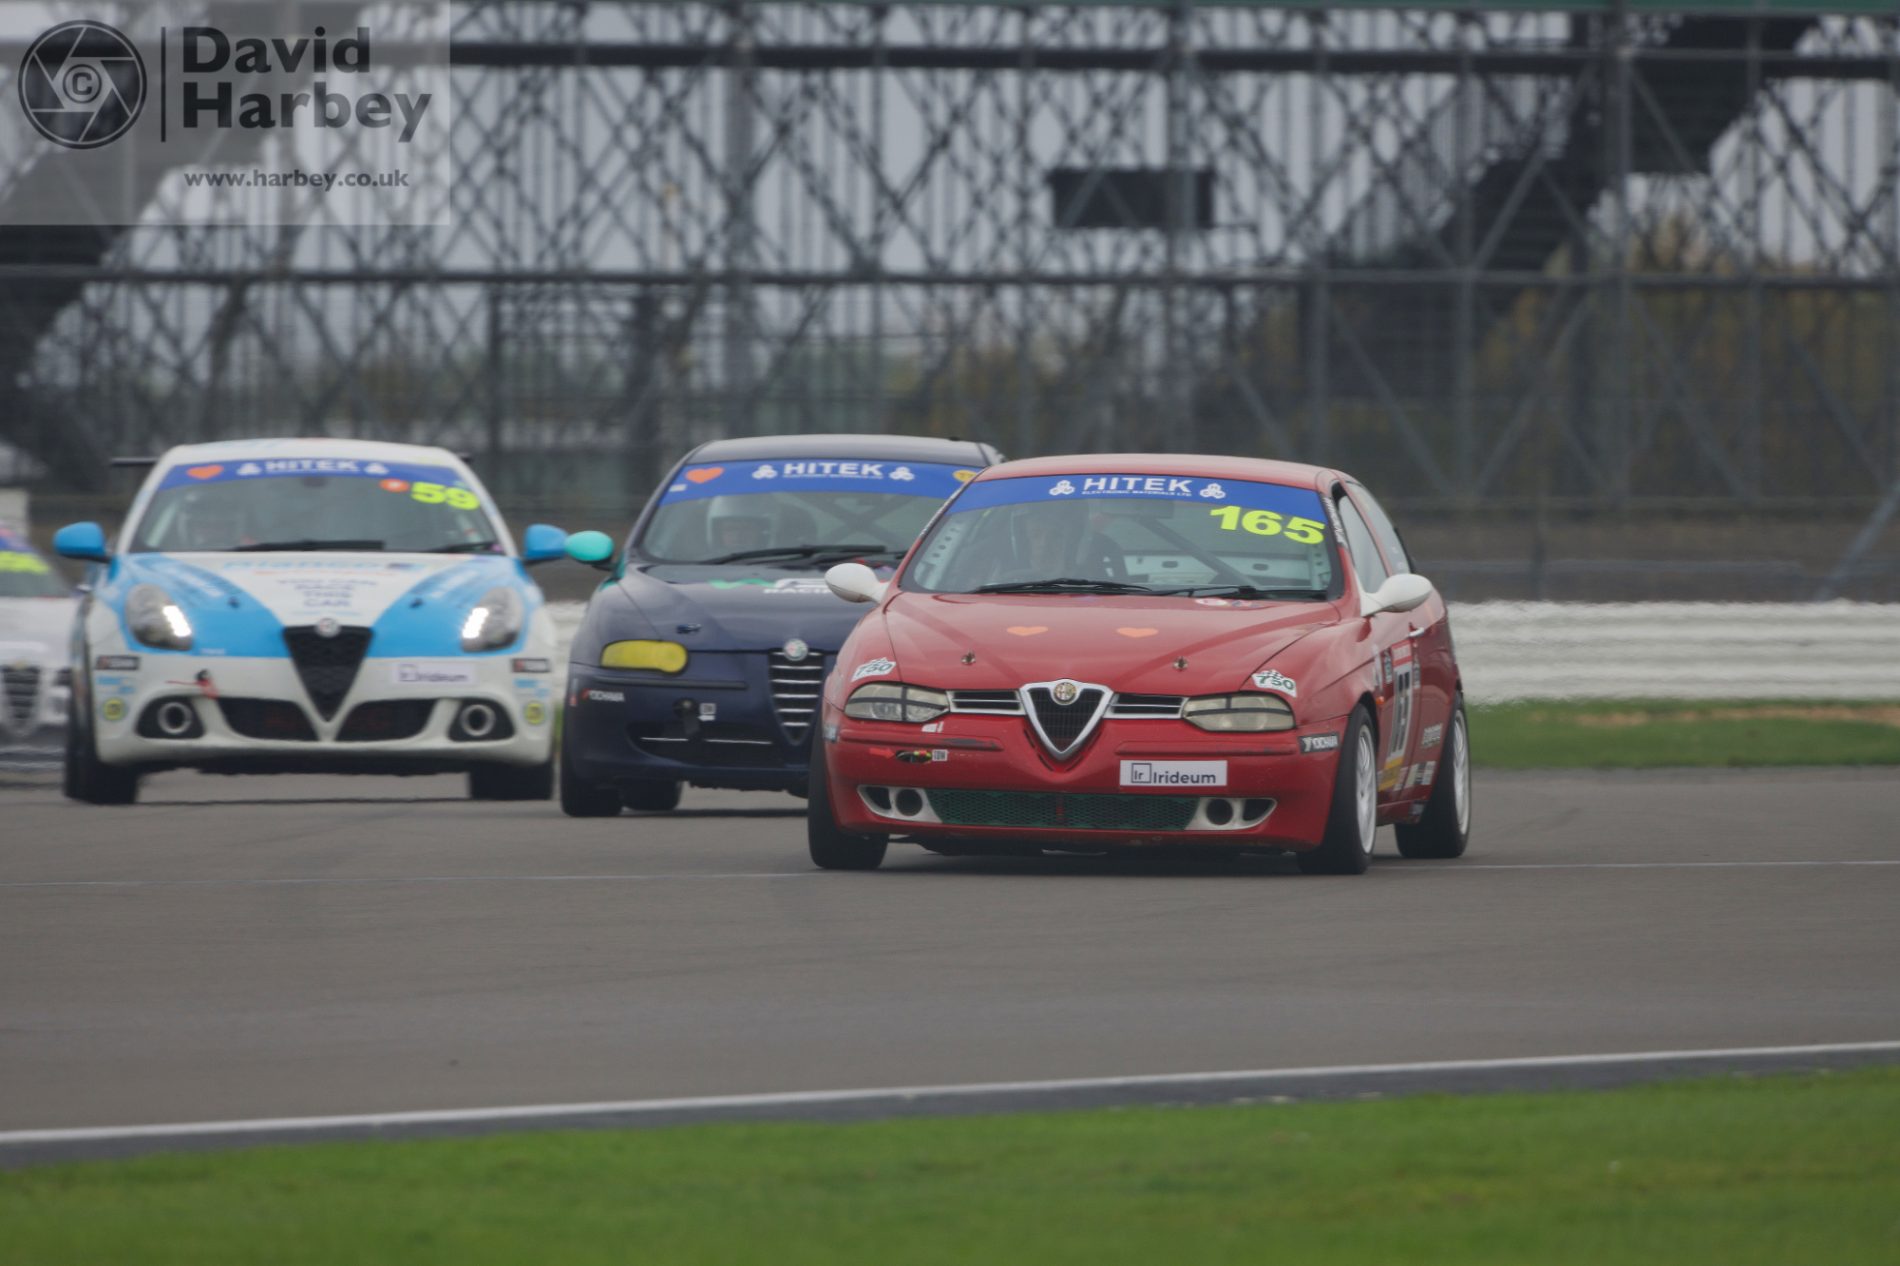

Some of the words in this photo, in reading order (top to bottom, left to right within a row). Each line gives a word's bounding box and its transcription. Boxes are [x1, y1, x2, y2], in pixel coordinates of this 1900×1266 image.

[266, 460, 360, 472] HITEK
[784, 463, 884, 477] HITEK
[1083, 477, 1192, 493] HITEK
[411, 481, 480, 510] 59
[1209, 505, 1326, 544] 165
[857, 662, 893, 677] 750
[1256, 675, 1295, 690] 750
[1153, 771, 1217, 784] Irideum
